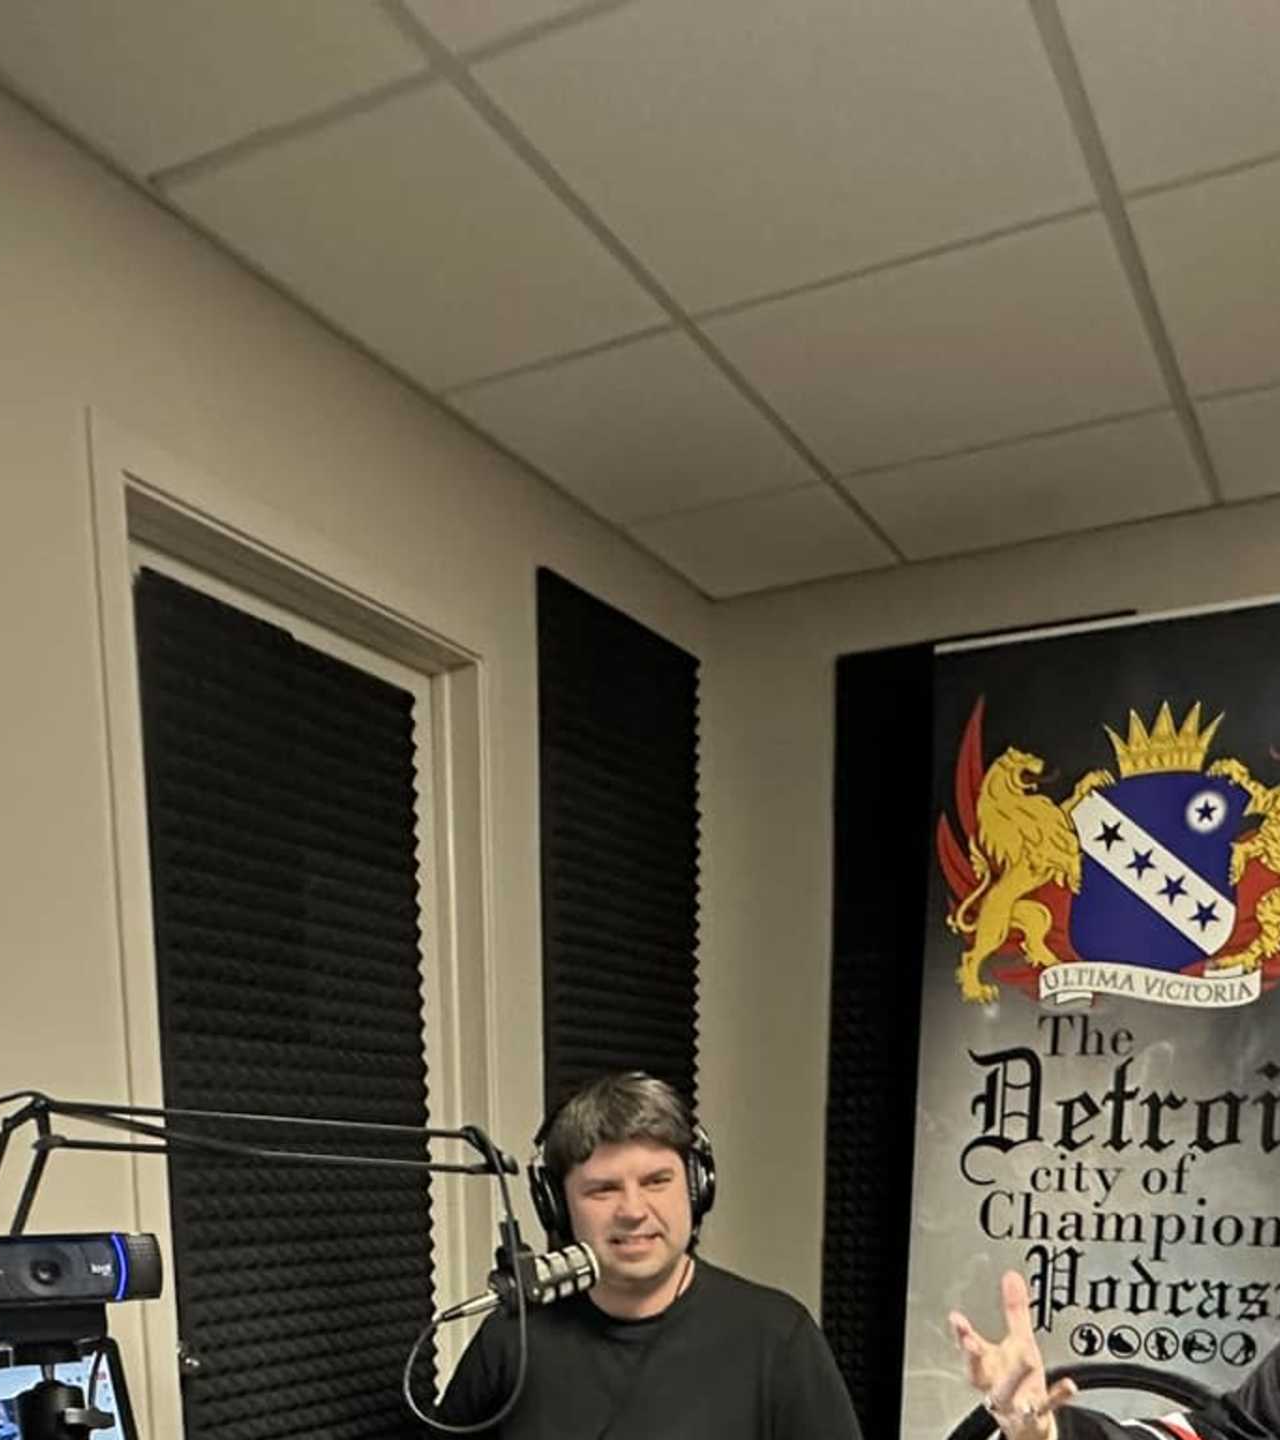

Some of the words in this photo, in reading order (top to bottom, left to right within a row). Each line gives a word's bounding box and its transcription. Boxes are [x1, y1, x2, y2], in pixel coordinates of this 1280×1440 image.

[1043, 966, 1134, 991] ULTIMA
[1144, 977, 1253, 1003] VICTORIA
[1038, 1014, 1134, 1056] The
[1030, 1155, 1122, 1204] city
[1142, 1154, 1196, 1194] of
